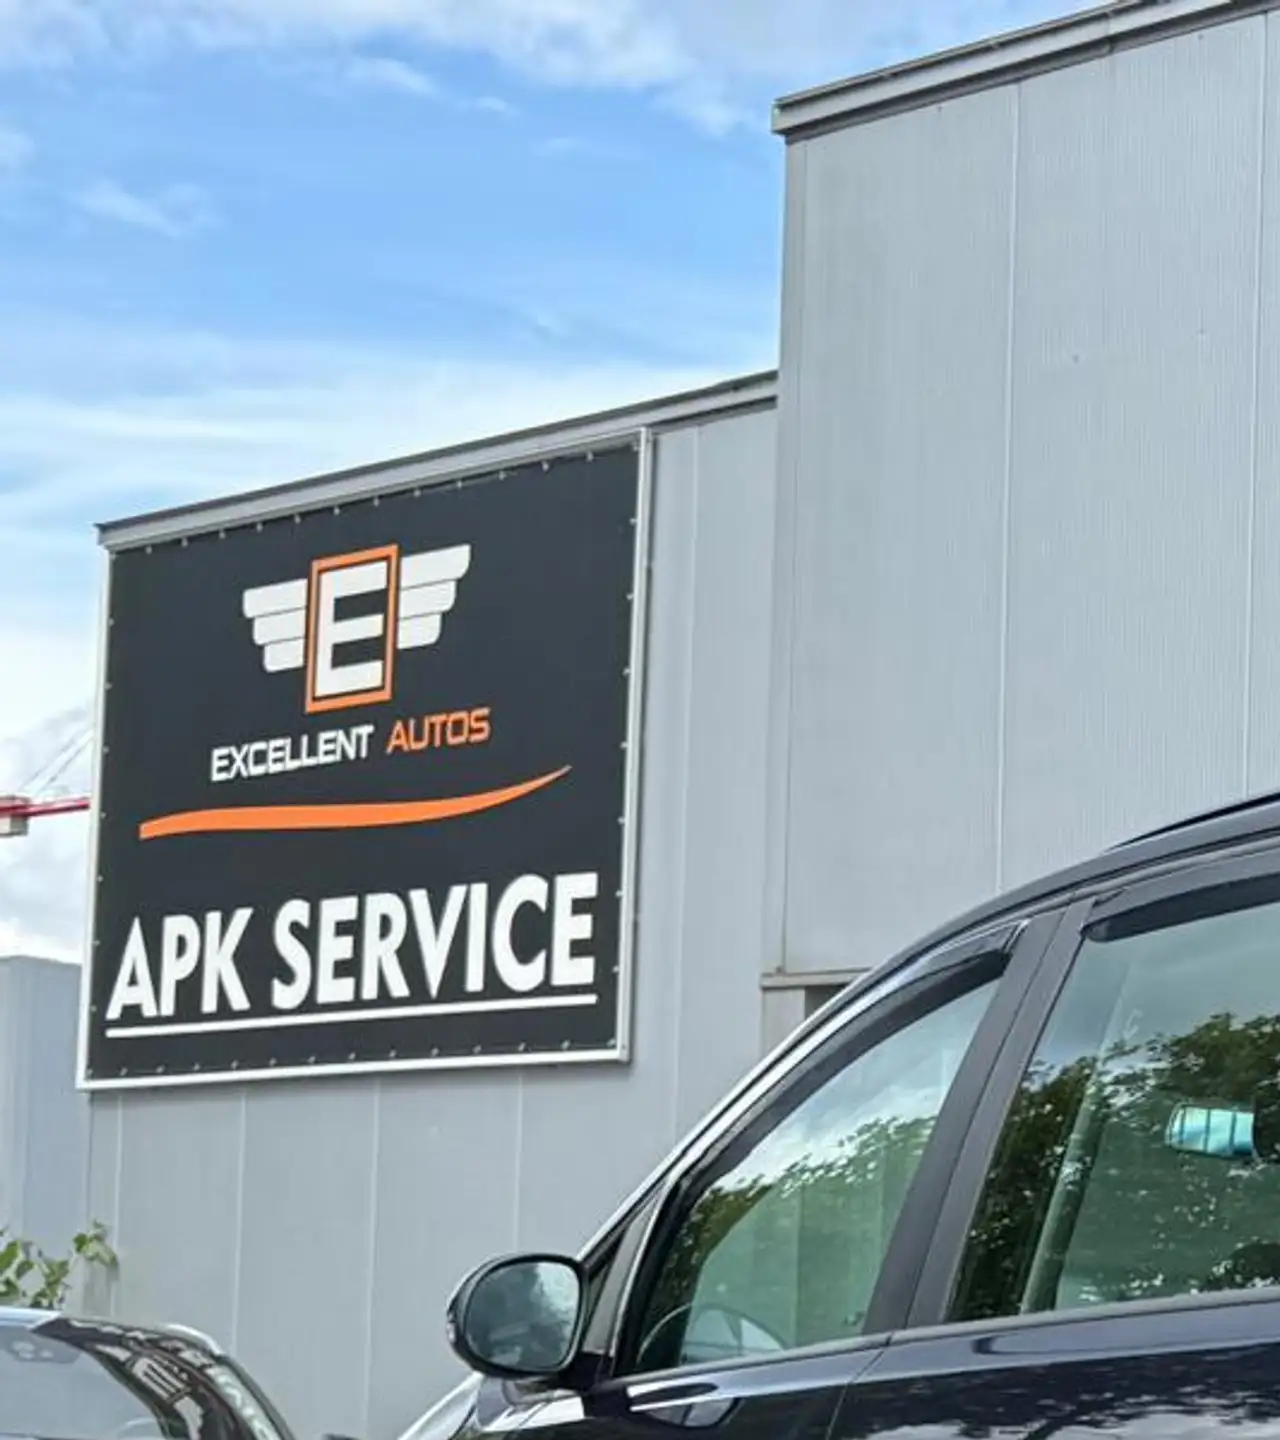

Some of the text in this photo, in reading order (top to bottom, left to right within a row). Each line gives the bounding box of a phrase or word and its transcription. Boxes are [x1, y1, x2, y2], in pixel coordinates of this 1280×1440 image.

[210, 707, 491, 781] EXCELLENT AUTOS
[105, 871, 599, 1021] APK SERVICE
